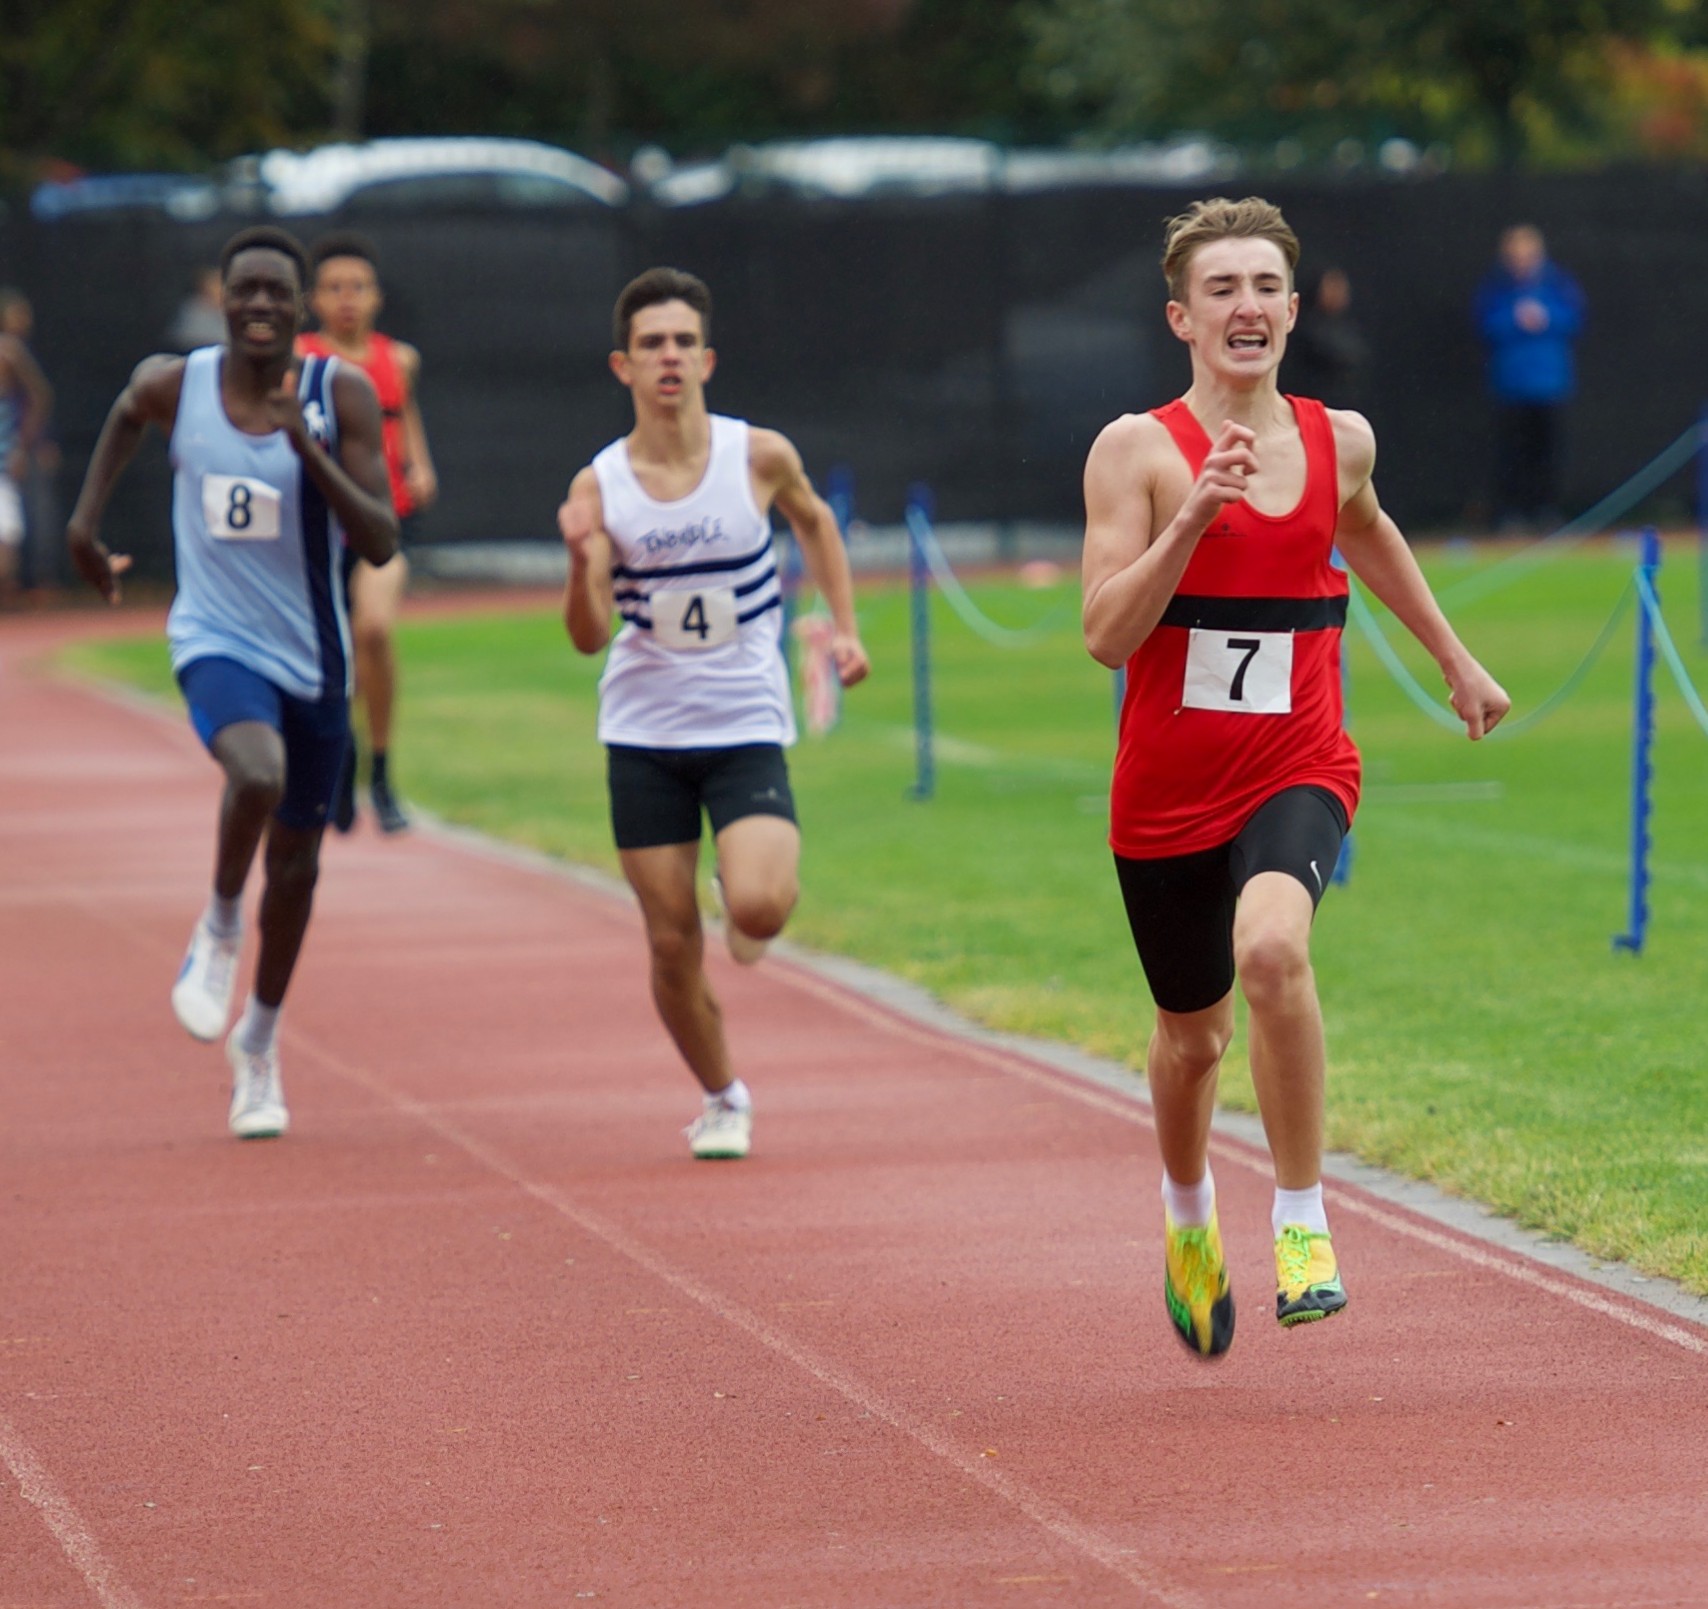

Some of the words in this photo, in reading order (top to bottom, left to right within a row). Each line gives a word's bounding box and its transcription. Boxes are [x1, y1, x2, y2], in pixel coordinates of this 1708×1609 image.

[227, 484, 252, 529] 8
[681, 595, 710, 640] 4
[1226, 638, 1261, 701] 7
